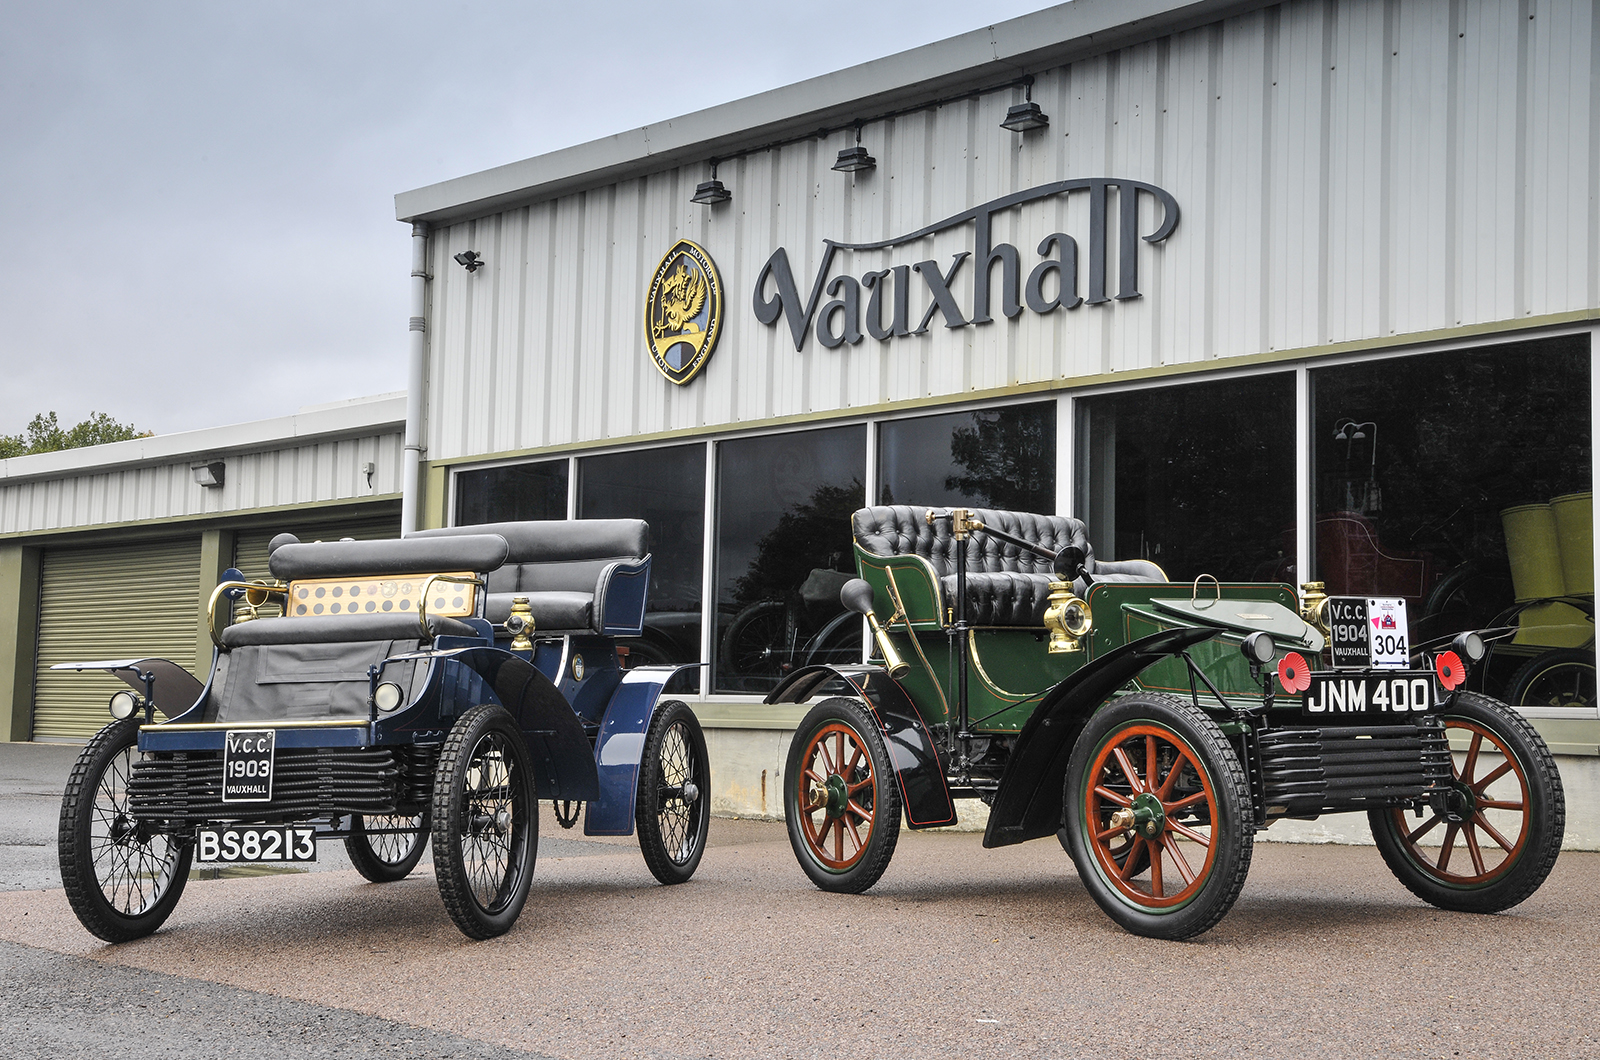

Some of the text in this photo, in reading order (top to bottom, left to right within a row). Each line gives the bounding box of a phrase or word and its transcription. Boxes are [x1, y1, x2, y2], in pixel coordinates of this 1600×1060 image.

[689, 246, 714, 279] MOTORS
[752, 176, 1180, 353] Vauxhall
[650, 251, 679, 304] VAUXHALL
[692, 318, 716, 369] ENGLAND
[1332, 604, 1367, 621] V.C.C.
[1332, 624, 1368, 642] 1904
[1334, 647, 1369, 657] VAUXHALL
[1374, 634, 1407, 656] 304
[1308, 678, 1429, 713] JNM 400
[229, 738, 270, 754] V.C.C.
[228, 759, 270, 778] 1903
[226, 784, 267, 794] VAUXHALL
[200, 829, 315, 861] BS8213
